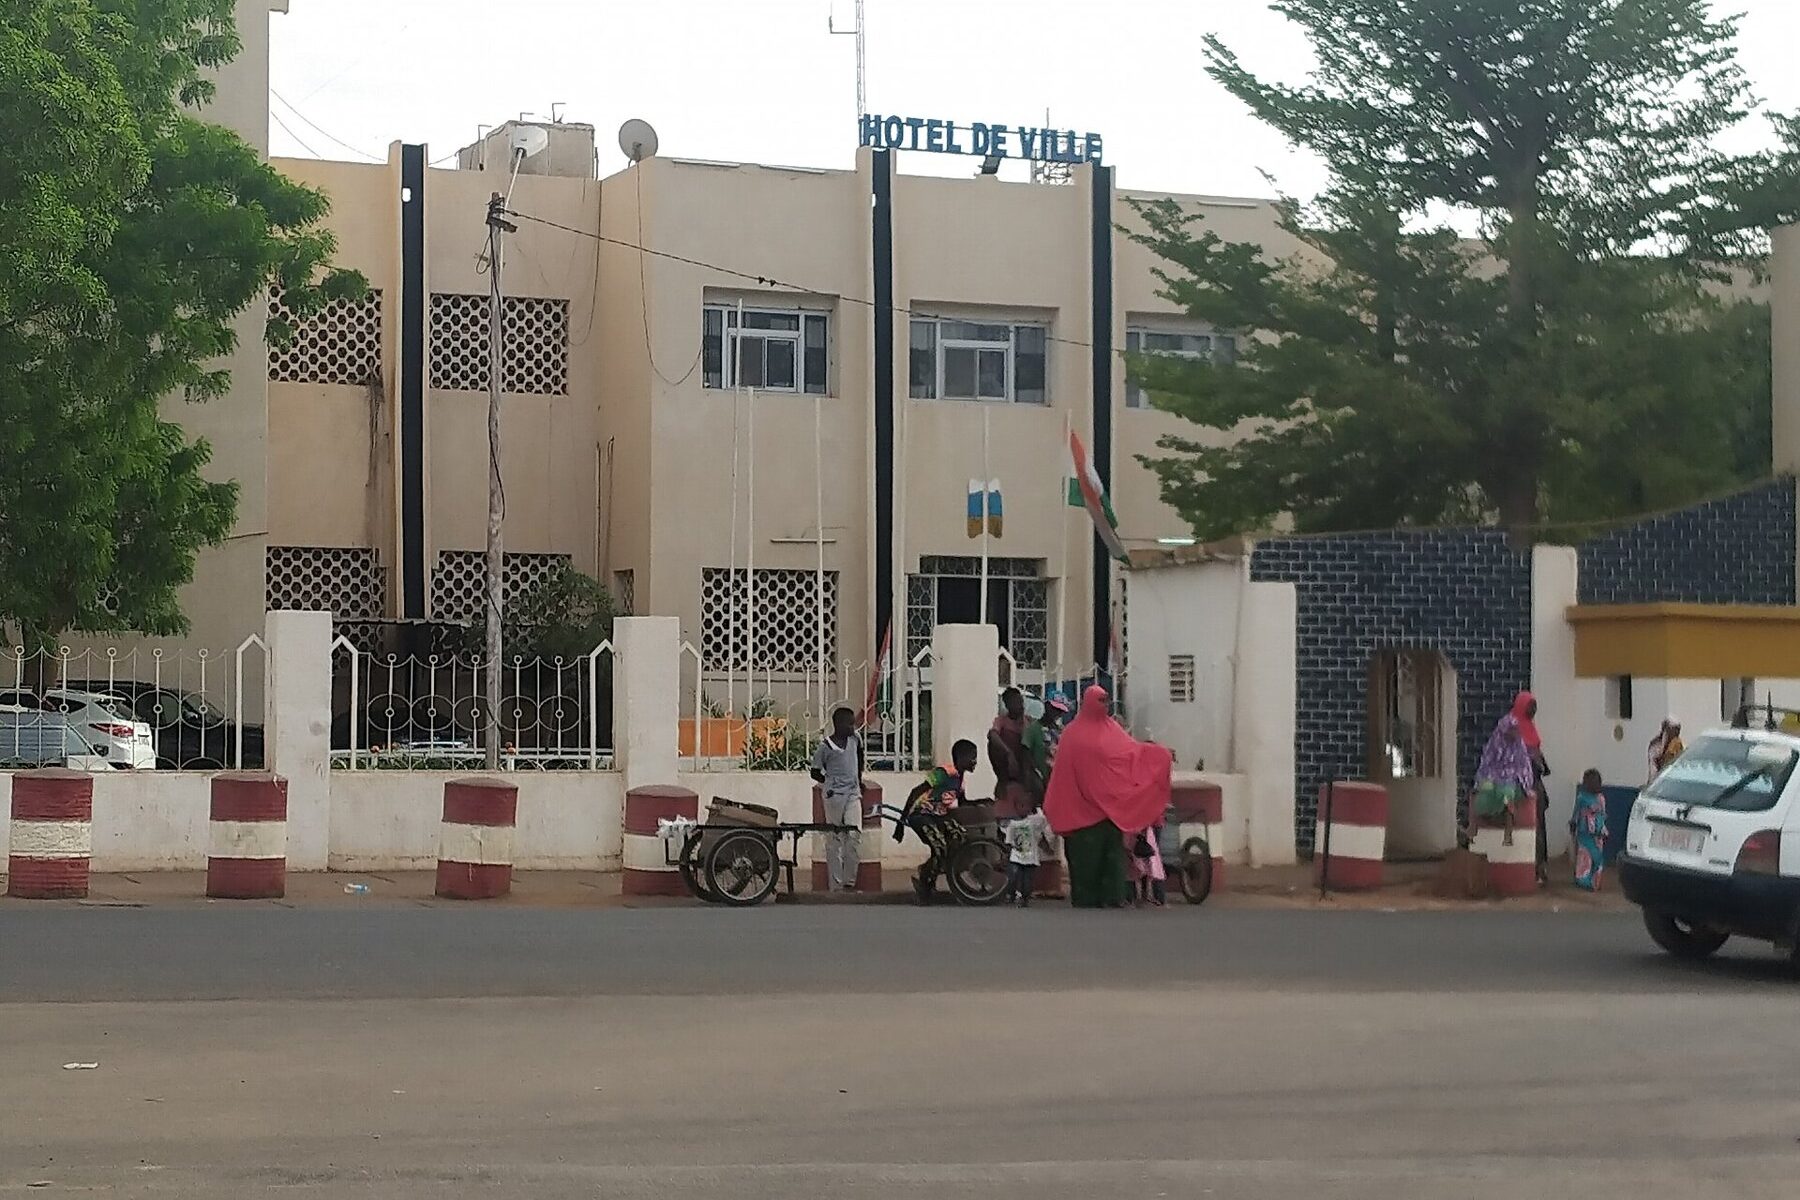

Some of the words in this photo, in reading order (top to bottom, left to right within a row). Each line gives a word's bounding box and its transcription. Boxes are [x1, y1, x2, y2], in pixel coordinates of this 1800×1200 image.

[860, 113, 961, 154] HOTEL
[972, 122, 1007, 158] DE
[1018, 126, 1102, 165] VILLE
